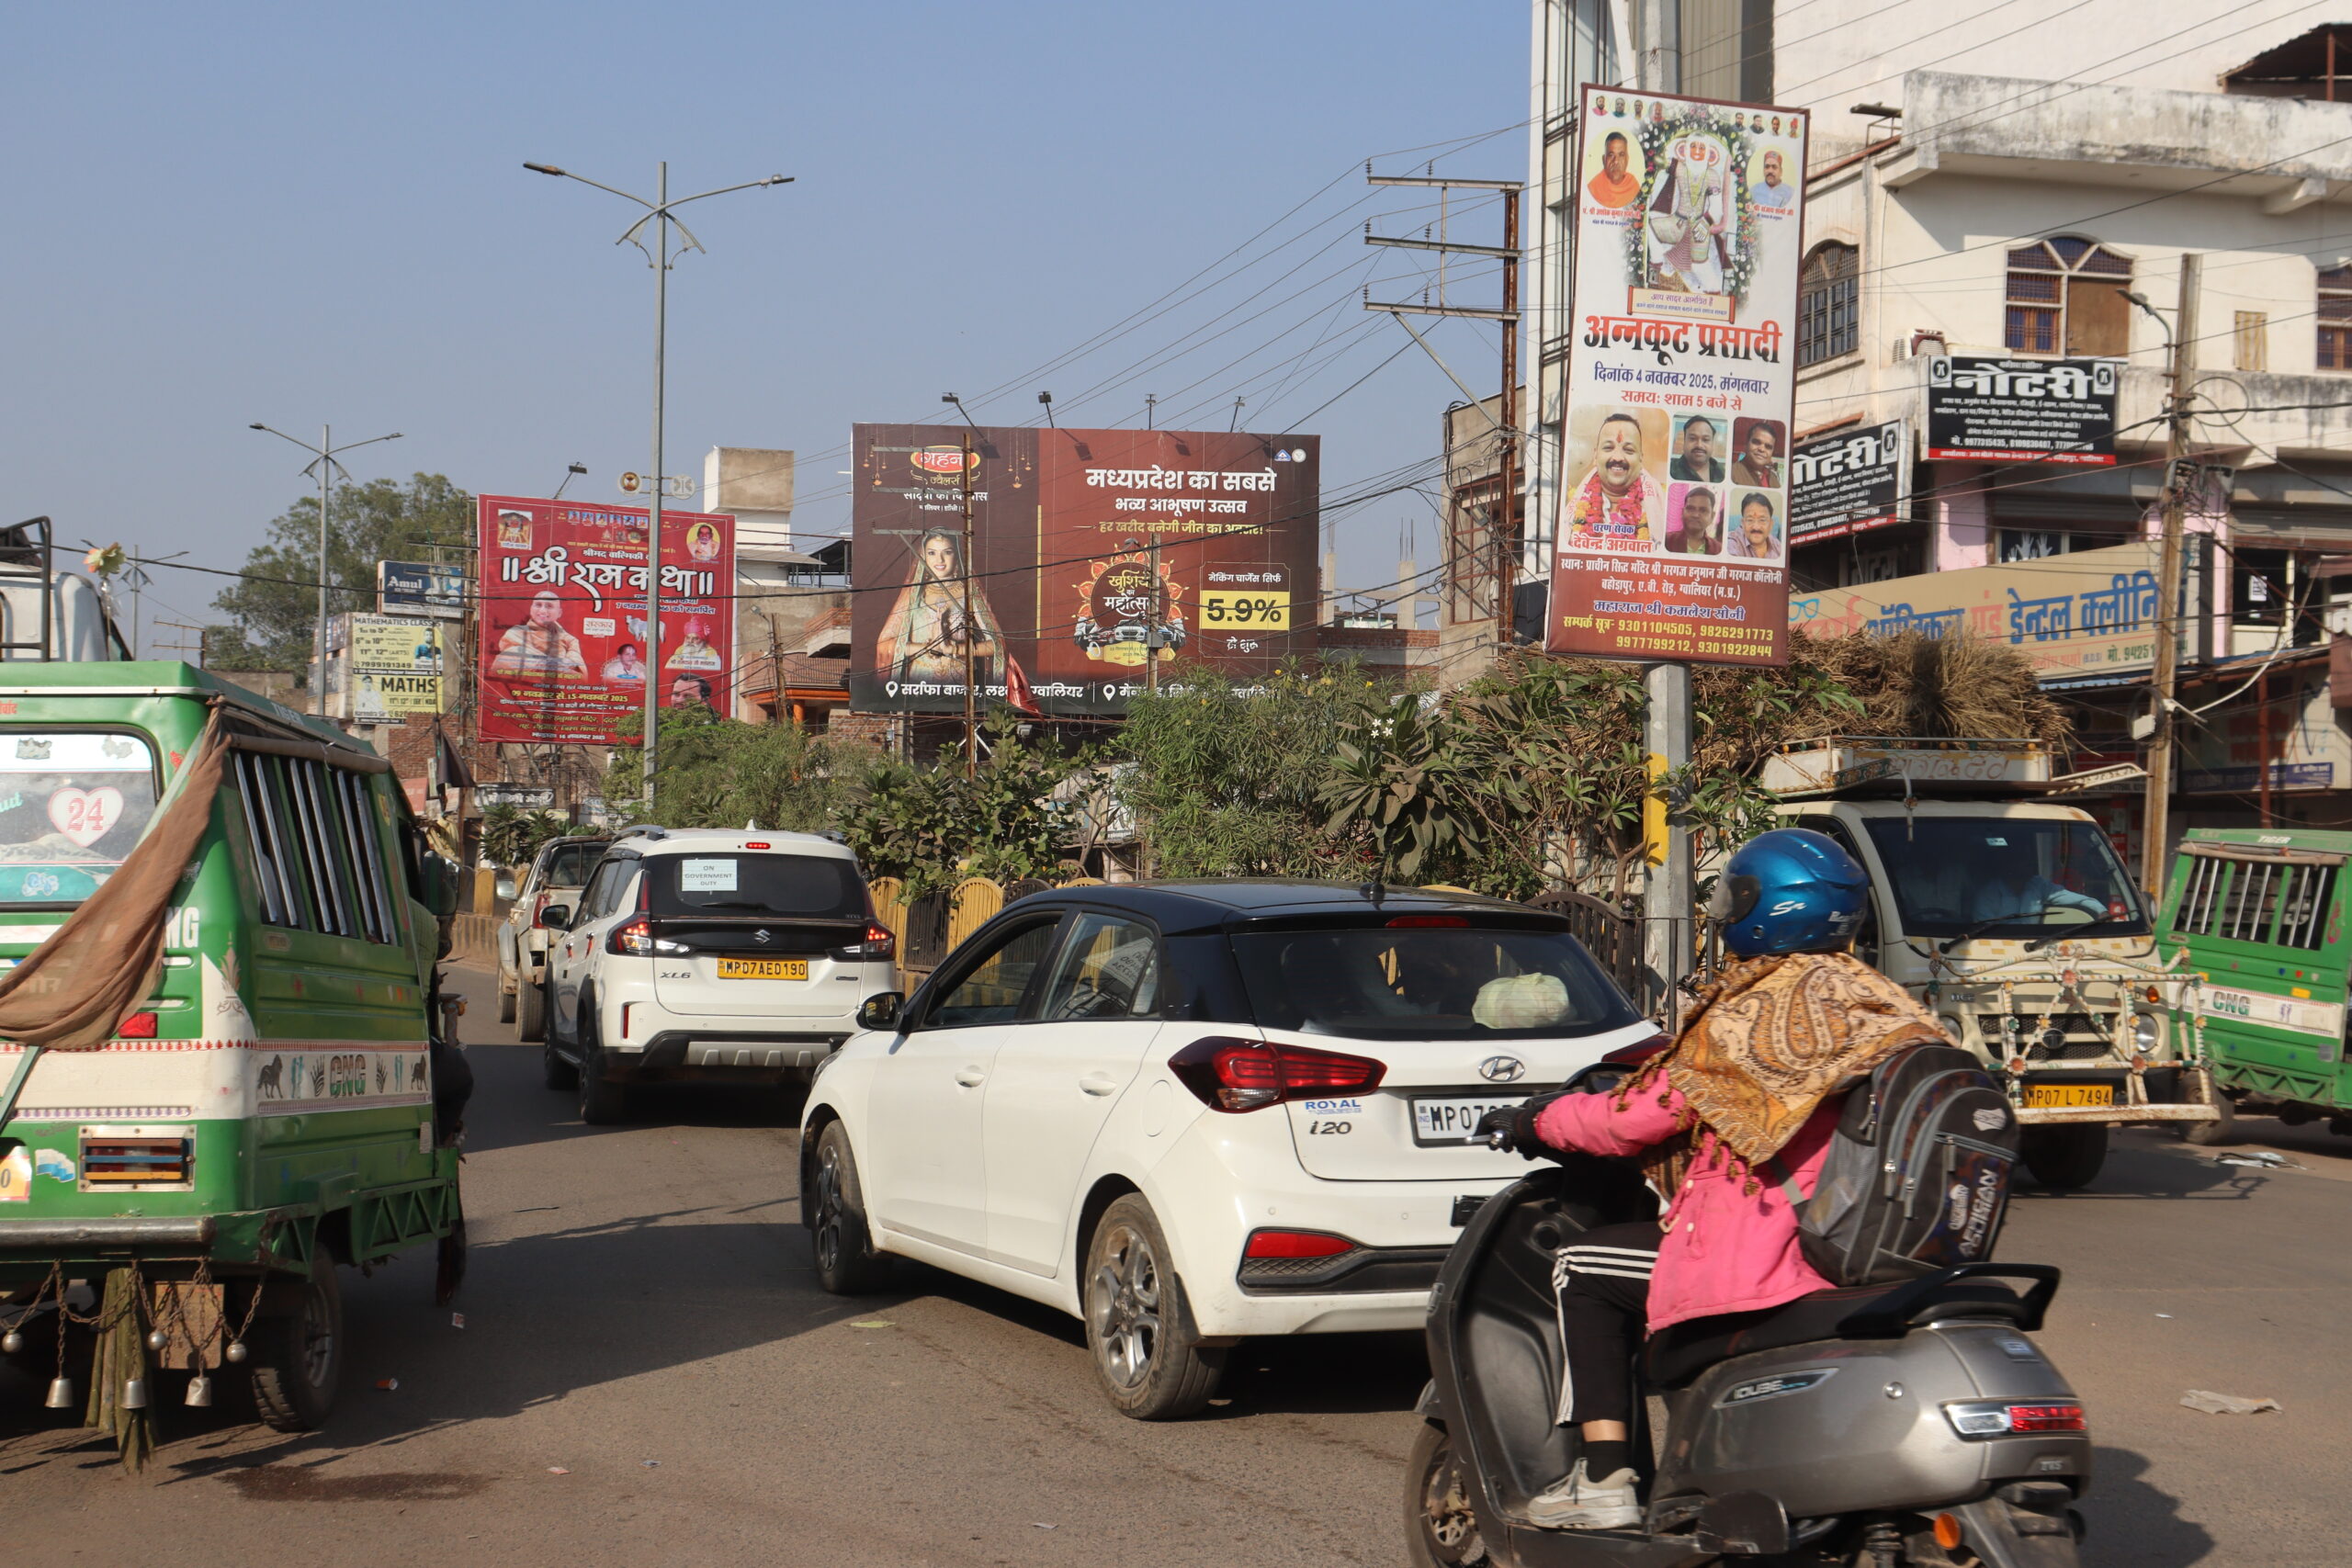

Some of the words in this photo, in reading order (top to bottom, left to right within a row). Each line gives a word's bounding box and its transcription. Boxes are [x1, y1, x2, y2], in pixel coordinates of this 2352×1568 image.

[1651, 293, 1664, 301] आप
[1666, 294, 1681, 304] सादर
[1683, 295, 1707, 305] आमंत्रित
[1584, 314, 1693, 366] अन्नकूट
[1696, 320, 1783, 364] प्रसादी
[1594, 360, 1634, 384] दिनांक
[1635, 368, 1643, 383] 4
[1645, 368, 1687, 388] नवम्बर
[1720, 371, 1770, 395] मंगलवार
[1952, 362, 2094, 400] नोटरी
[1664, 392, 1693, 407] शाम
[1697, 395, 1703, 408] 5
[1706, 393, 1728, 410] बजे
[1730, 394, 1743, 412] से
[920, 451, 964, 468] गहन
[1085, 464, 1184, 491] मध्यप्रदेश
[1187, 470, 1217, 491] का
[1222, 467, 1277, 492] सबसे
[1114, 497, 1147, 512] भव्य
[1149, 498, 1205, 517] आभूषण
[1207, 500, 1248, 514] उत्सव
[1099, 521, 1114, 534] हर
[1114, 519, 1145, 534] खरीद
[1147, 519, 1180, 534] बनेगी
[1182, 520, 1204, 535] जीत
[1206, 524, 1222, 535] का
[1612, 522, 1635, 535] सेवक
[1573, 532, 1604, 550] देवेन्द्र
[1607, 536, 1653, 553] अग्रवाल
[1207, 571, 1234, 582] मेकिंग
[1262, 572, 1283, 583] सिर्फ
[1586, 558, 1610, 572] प्राचीन
[1611, 559, 1629, 574] सिद्ध
[1631, 560, 1649, 575] मंदिर
[1651, 561, 1661, 576] श्री
[1663, 565, 1687, 577] गरगज
[1689, 566, 1715, 581] हनुमान
[1717, 565, 1727, 581] जी
[1729, 569, 1752, 582] गरगज
[1754, 568, 1783, 584] कॉलोनी
[387, 575, 423, 589] Amul
[571, 561, 628, 613] राम
[1679, 581, 1713, 597] ग्वालियर
[1713, 583, 1741, 602] (म.प्र.)
[1207, 598, 1282, 623] 5.9%
[1594, 600, 1643, 615] महाराज
[1645, 600, 1662, 616] श्री
[1664, 602, 1711, 619] कमलेश
[1713, 604, 1746, 622] सोनी
[2007, 587, 2075, 645] डेन्टल
[2080, 570, 2159, 637] क्लीनि
[354, 616, 409, 626] MATHEMATICS
[410, 618, 442, 627] CLASSS
[1563, 614, 1593, 629] सम्पर्क
[1618, 618, 1696, 637] 9301104505,
[1700, 624, 1774, 641] 9826291773
[1616, 635, 1694, 654] 9977799212,
[1698, 640, 1772, 658] 9301922844
[2108, 646, 2121, 662] मो.
[381, 676, 435, 694] MATHS
[900, 681, 941, 696] सर्राफा
[943, 682, 983, 698] बाजर,
[1031, 682, 1083, 698] ग्वालियर
[66, 797, 104, 832] 24
[2256, 834, 2293, 844] TIGER
[165, 907, 199, 949] NG
[660, 971, 692, 979] XL6
[726, 961, 806, 976] MP07AE0190
[2211, 990, 2251, 1017] CNG
[330, 1054, 367, 1099] CNG
[1305, 1099, 1362, 1111] ROYAL
[2027, 1088, 2060, 1107] MP07
[2077, 1089, 2111, 1106] 7494
[1309, 1120, 1352, 1135] i20
